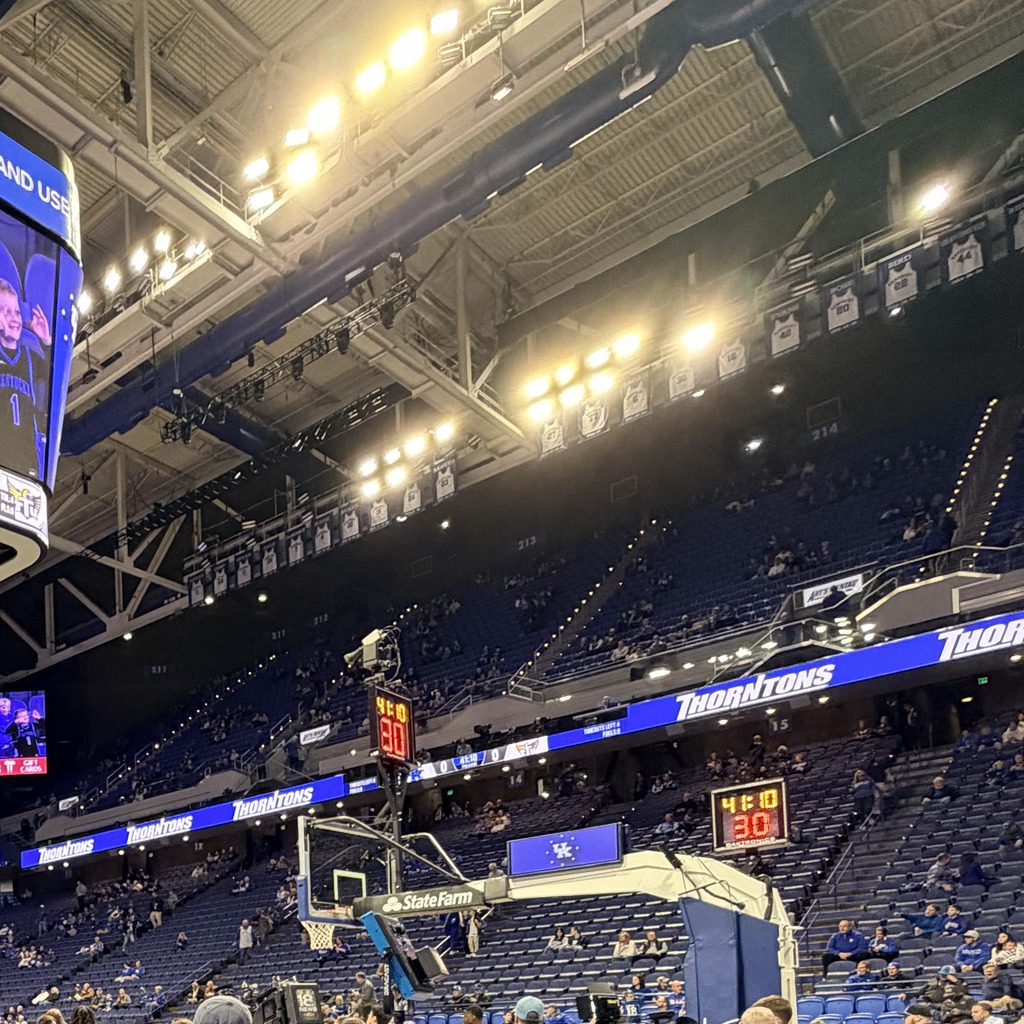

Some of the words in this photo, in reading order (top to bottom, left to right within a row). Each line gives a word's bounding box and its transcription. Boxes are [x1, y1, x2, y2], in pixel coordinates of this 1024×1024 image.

[38, 181, 71, 217] USE
[10, 393, 21, 426] 1
[677, 664, 835, 721] THORNTONS
[377, 696, 407, 723] 41:10
[233, 787, 313, 821] THORNTONS
[722, 789, 778, 813] 41:10
[127, 816, 193, 844] THORNTONS
[734, 812, 770, 839] 30
[39, 839, 94, 864] THORNTONS
[297, 994, 314, 1008] 18
